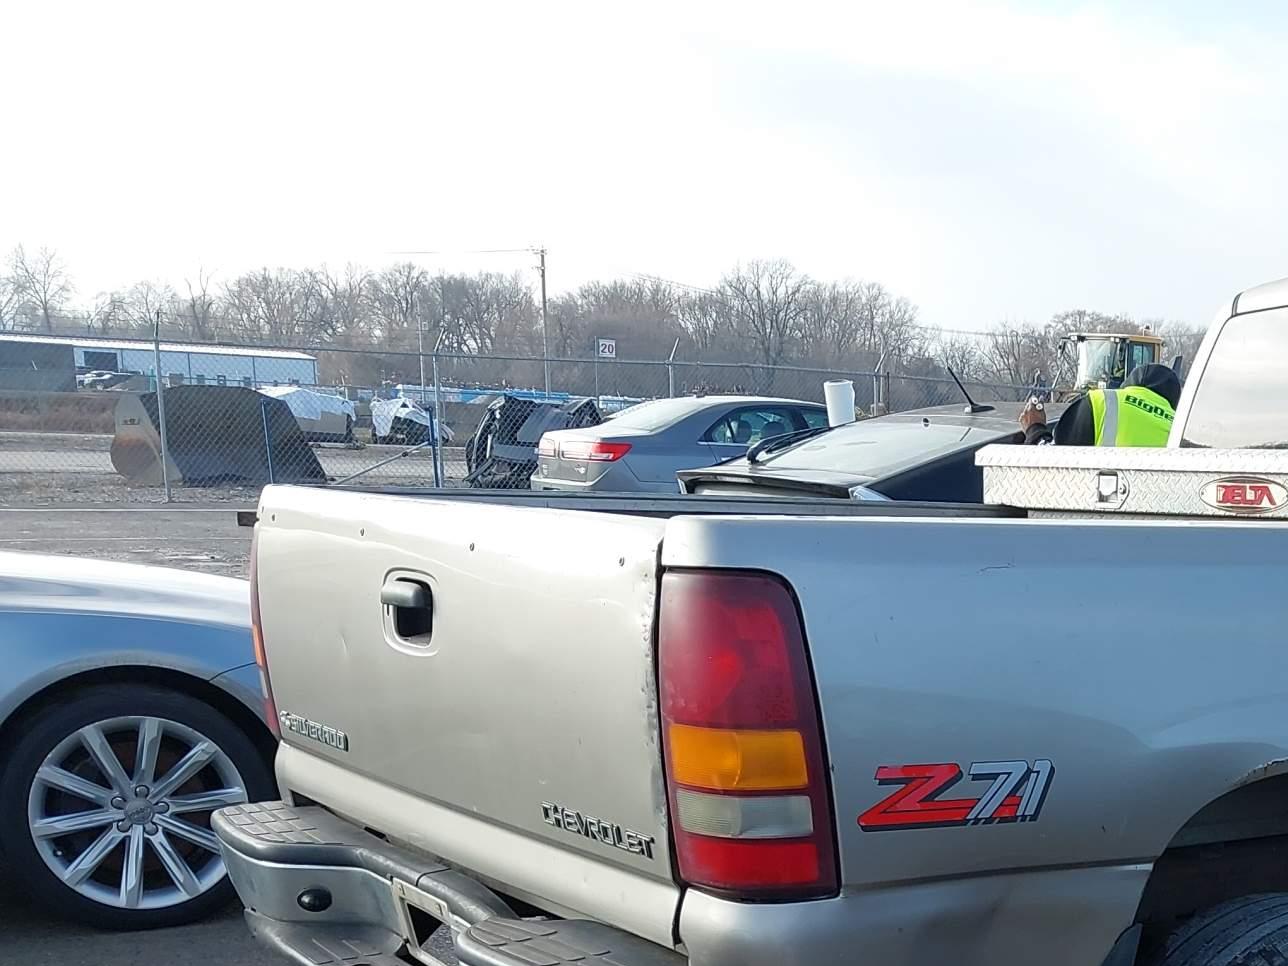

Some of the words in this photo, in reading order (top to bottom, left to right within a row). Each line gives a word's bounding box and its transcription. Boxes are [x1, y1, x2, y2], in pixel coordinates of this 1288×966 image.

[601, 343, 614, 354] 20
[1216, 484, 1276, 505] DELTA
[288, 713, 348, 752] SILVERADO
[857, 759, 1055, 832] Z71
[540, 800, 655, 860] CHEVROLET
